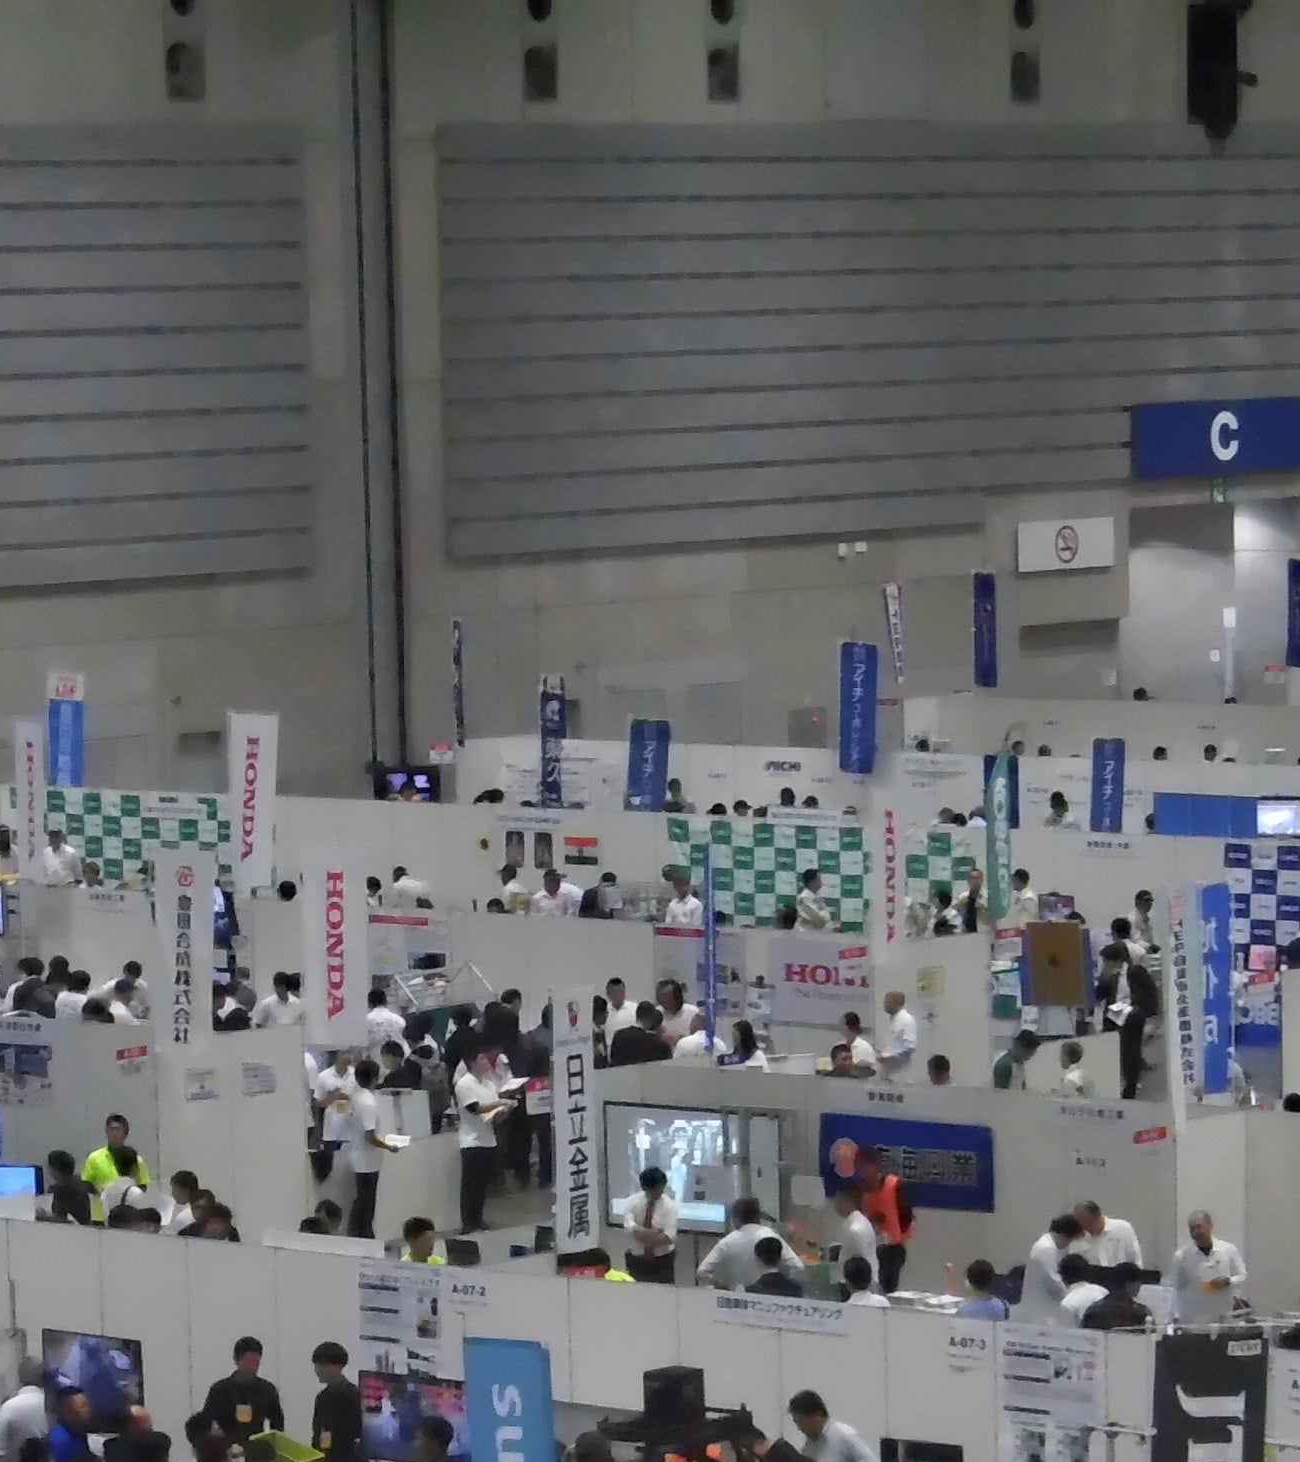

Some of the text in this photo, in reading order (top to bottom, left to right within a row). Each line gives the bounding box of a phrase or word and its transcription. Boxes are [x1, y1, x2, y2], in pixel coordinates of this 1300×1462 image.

[1210, 411, 1239, 460] C
[241, 737, 260, 862] HONDA
[326, 870, 346, 1020] HONDA
[566, 1053, 590, 1240] 日立金属
[452, 1284, 486, 1297] A-07-2
[949, 1336, 987, 1351] A-07-3
